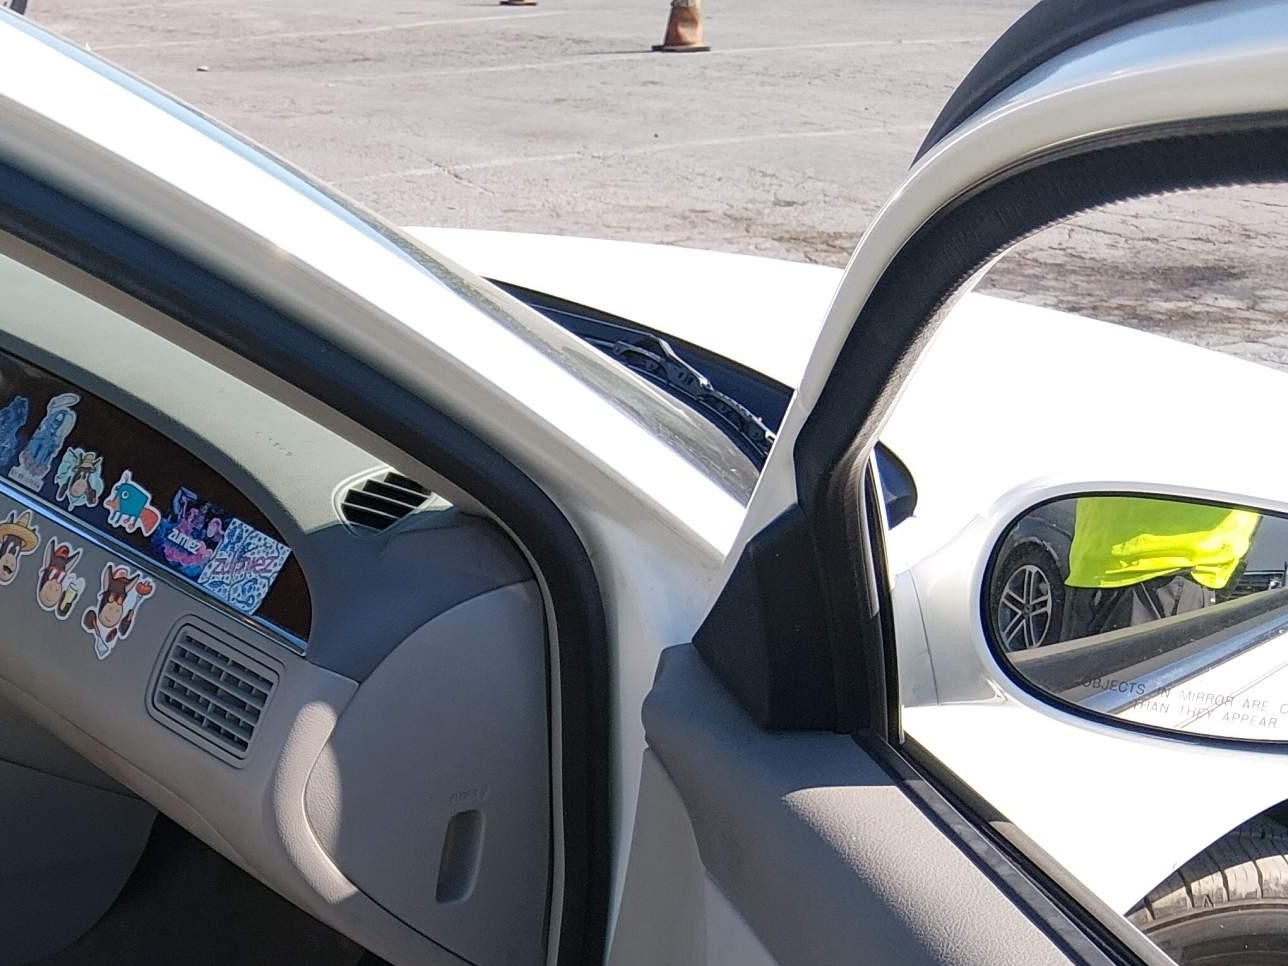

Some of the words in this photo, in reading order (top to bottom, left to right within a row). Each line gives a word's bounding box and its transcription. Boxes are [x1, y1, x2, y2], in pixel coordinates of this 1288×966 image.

[1081, 675, 1146, 695] OBJECTS
[1180, 689, 1234, 708] MIRROR
[1242, 698, 1272, 711] ARE
[1133, 699, 1171, 714] THAN
[1222, 712, 1278, 729] APPEAR
